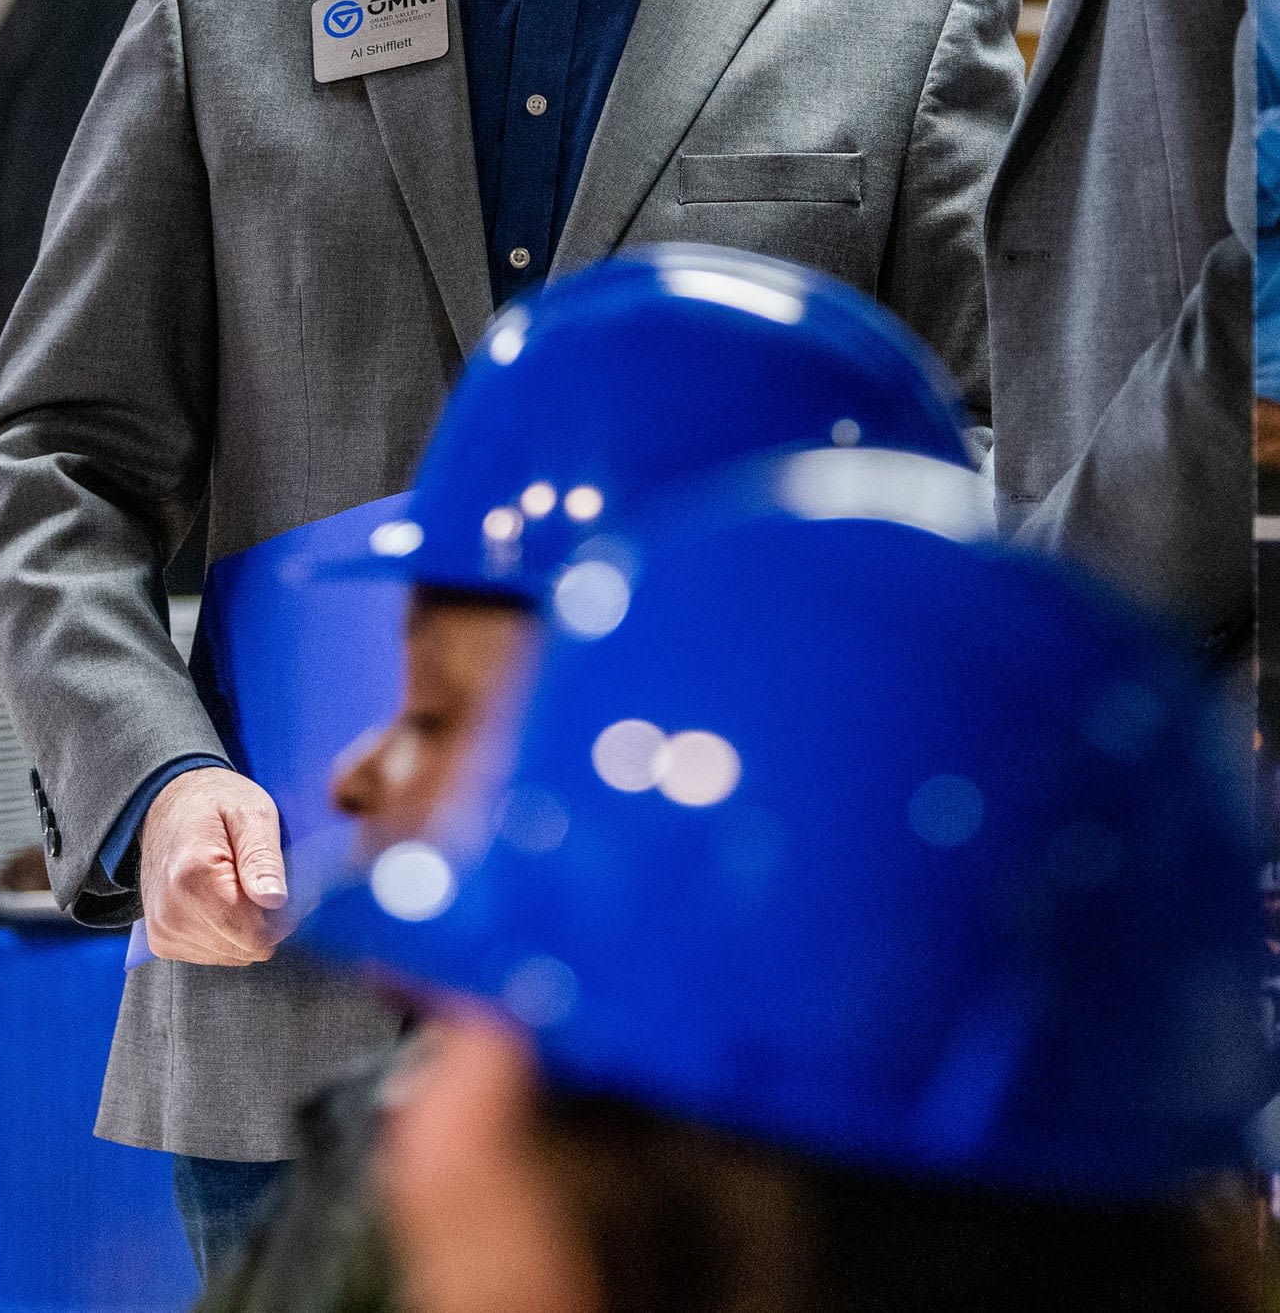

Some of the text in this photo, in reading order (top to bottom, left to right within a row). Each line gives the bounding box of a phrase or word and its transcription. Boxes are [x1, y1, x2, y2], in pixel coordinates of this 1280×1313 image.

[369, 9, 419, 25] GRAND VALLEY
[370, 12, 431, 31] STATE UNIVERSITY
[350, 37, 412, 60] Al Shifflett
